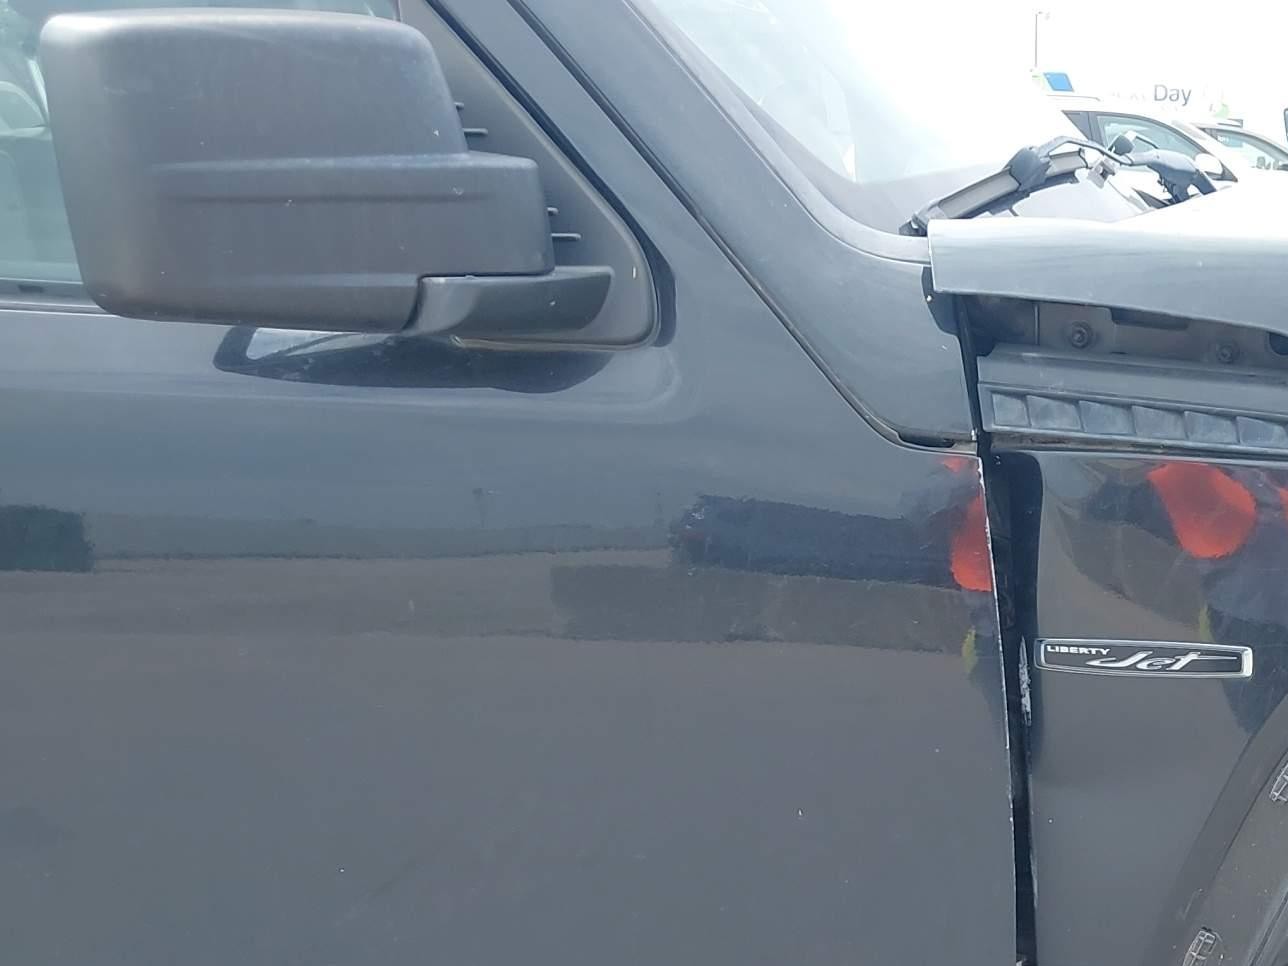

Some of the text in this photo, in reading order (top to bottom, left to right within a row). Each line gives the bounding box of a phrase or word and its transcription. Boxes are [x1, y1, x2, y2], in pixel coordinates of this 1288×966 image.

[1154, 84, 1192, 107] Day
[1046, 645, 1110, 655] LIBERTY
[1086, 651, 1237, 671] Jet
